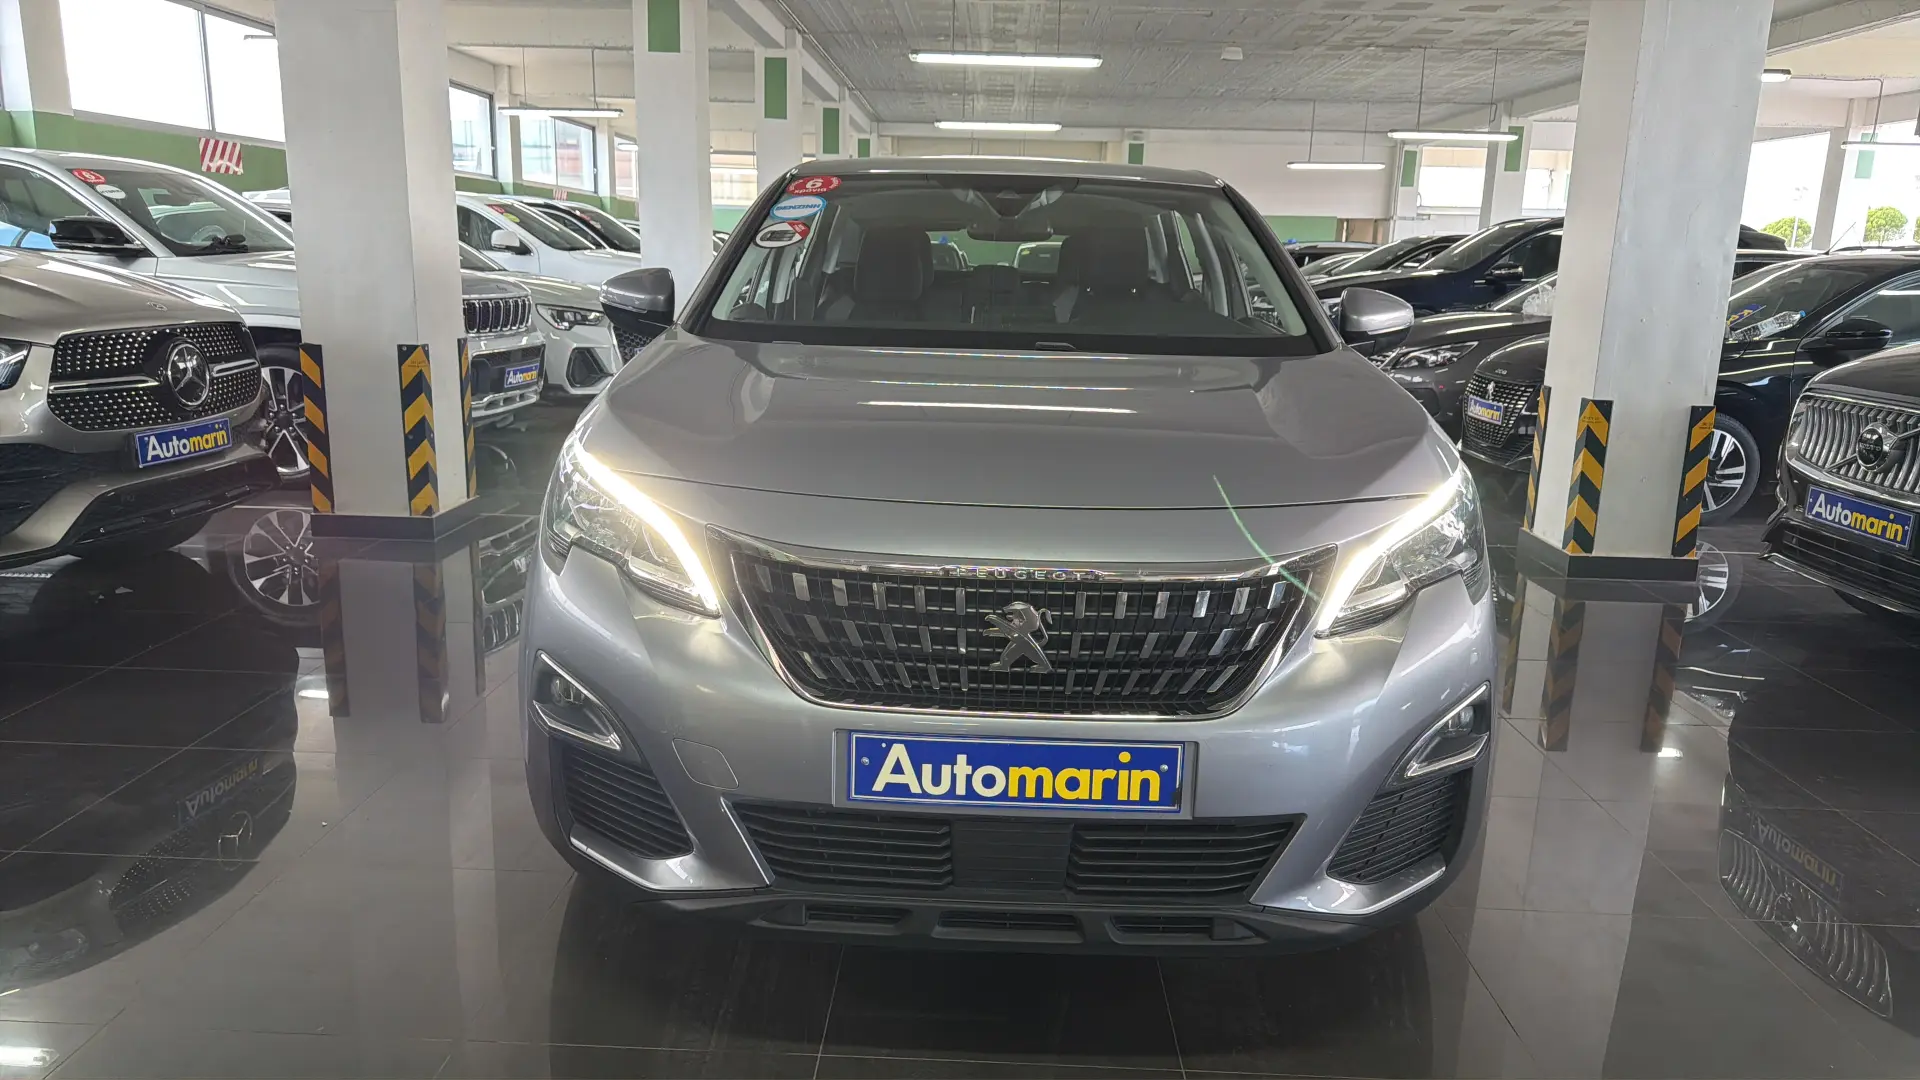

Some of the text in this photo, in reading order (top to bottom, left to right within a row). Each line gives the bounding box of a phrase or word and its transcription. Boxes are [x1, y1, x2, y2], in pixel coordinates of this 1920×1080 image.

[806, 178, 824, 189] 6
[147, 423, 228, 461] Automarin
[1811, 493, 1903, 541] Automarin
[957, 566, 1086, 581] PEUGEOT
[871, 743, 1161, 802] Automarin
